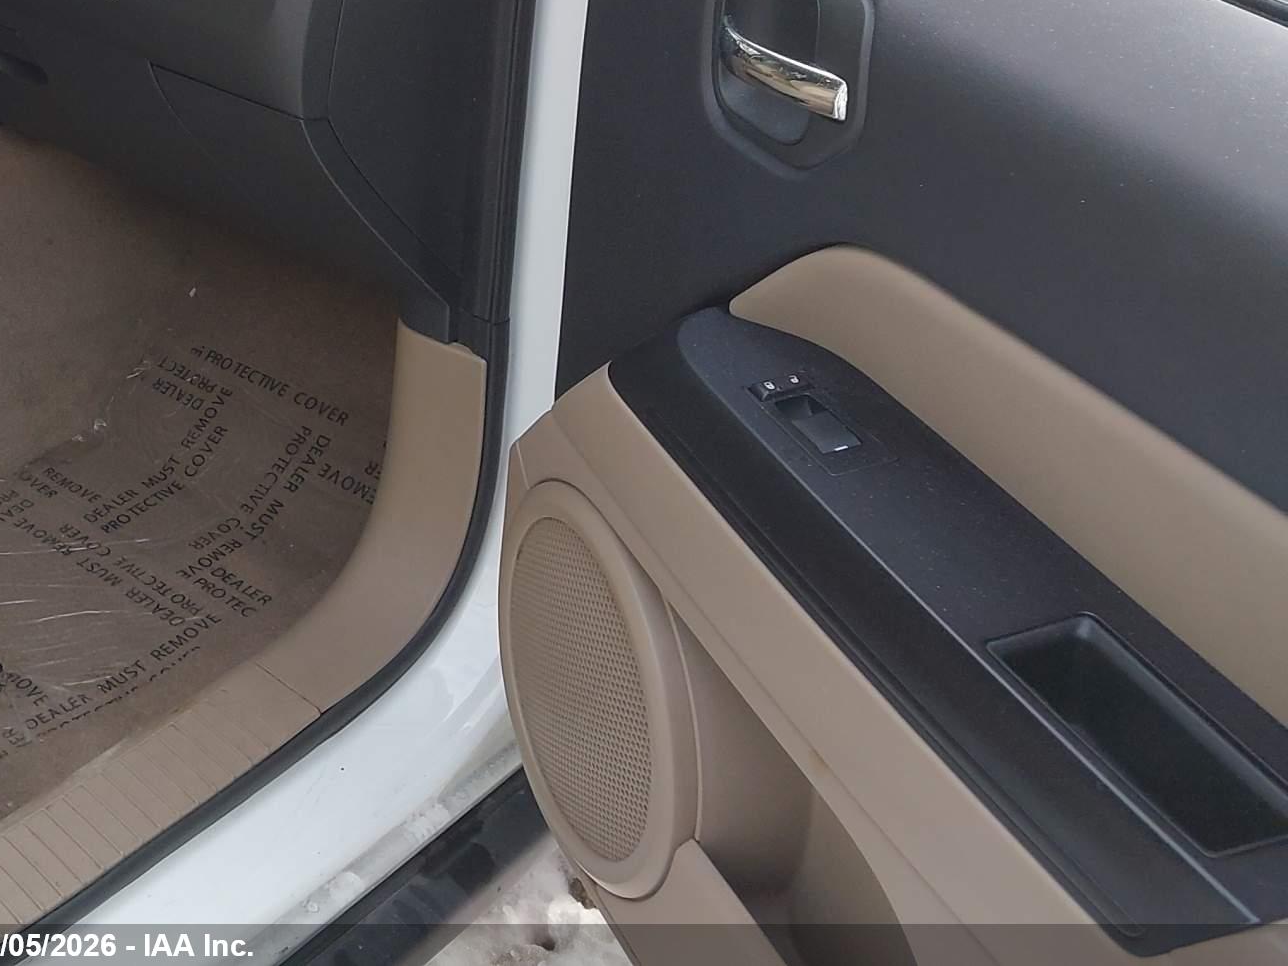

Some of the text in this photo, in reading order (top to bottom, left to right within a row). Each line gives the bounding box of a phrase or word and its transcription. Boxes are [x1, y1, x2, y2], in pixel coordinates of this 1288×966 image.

[152, 377, 205, 411] DEALER
[204, 349, 349, 426] PROTECTIVE COVER
[43, 467, 102, 503] REMOVE
[83, 386, 233, 523] DEALER MUST REMOVE
[100, 425, 228, 534] PROTECTIVE COVER
[188, 425, 312, 550] PROTECTIVE COVER
[176, 434, 330, 579] DEALER MUST REMOVE
[60, 523, 205, 617] PROTECTIVE COVER
[76, 557, 123, 587] MUST
[125, 585, 186, 627] DEALER
[210, 567, 273, 605] DEALER
[25, 693, 93, 730] DEALER
[96, 659, 148, 694] MUST
[149, 614, 223, 663] REMOVE
